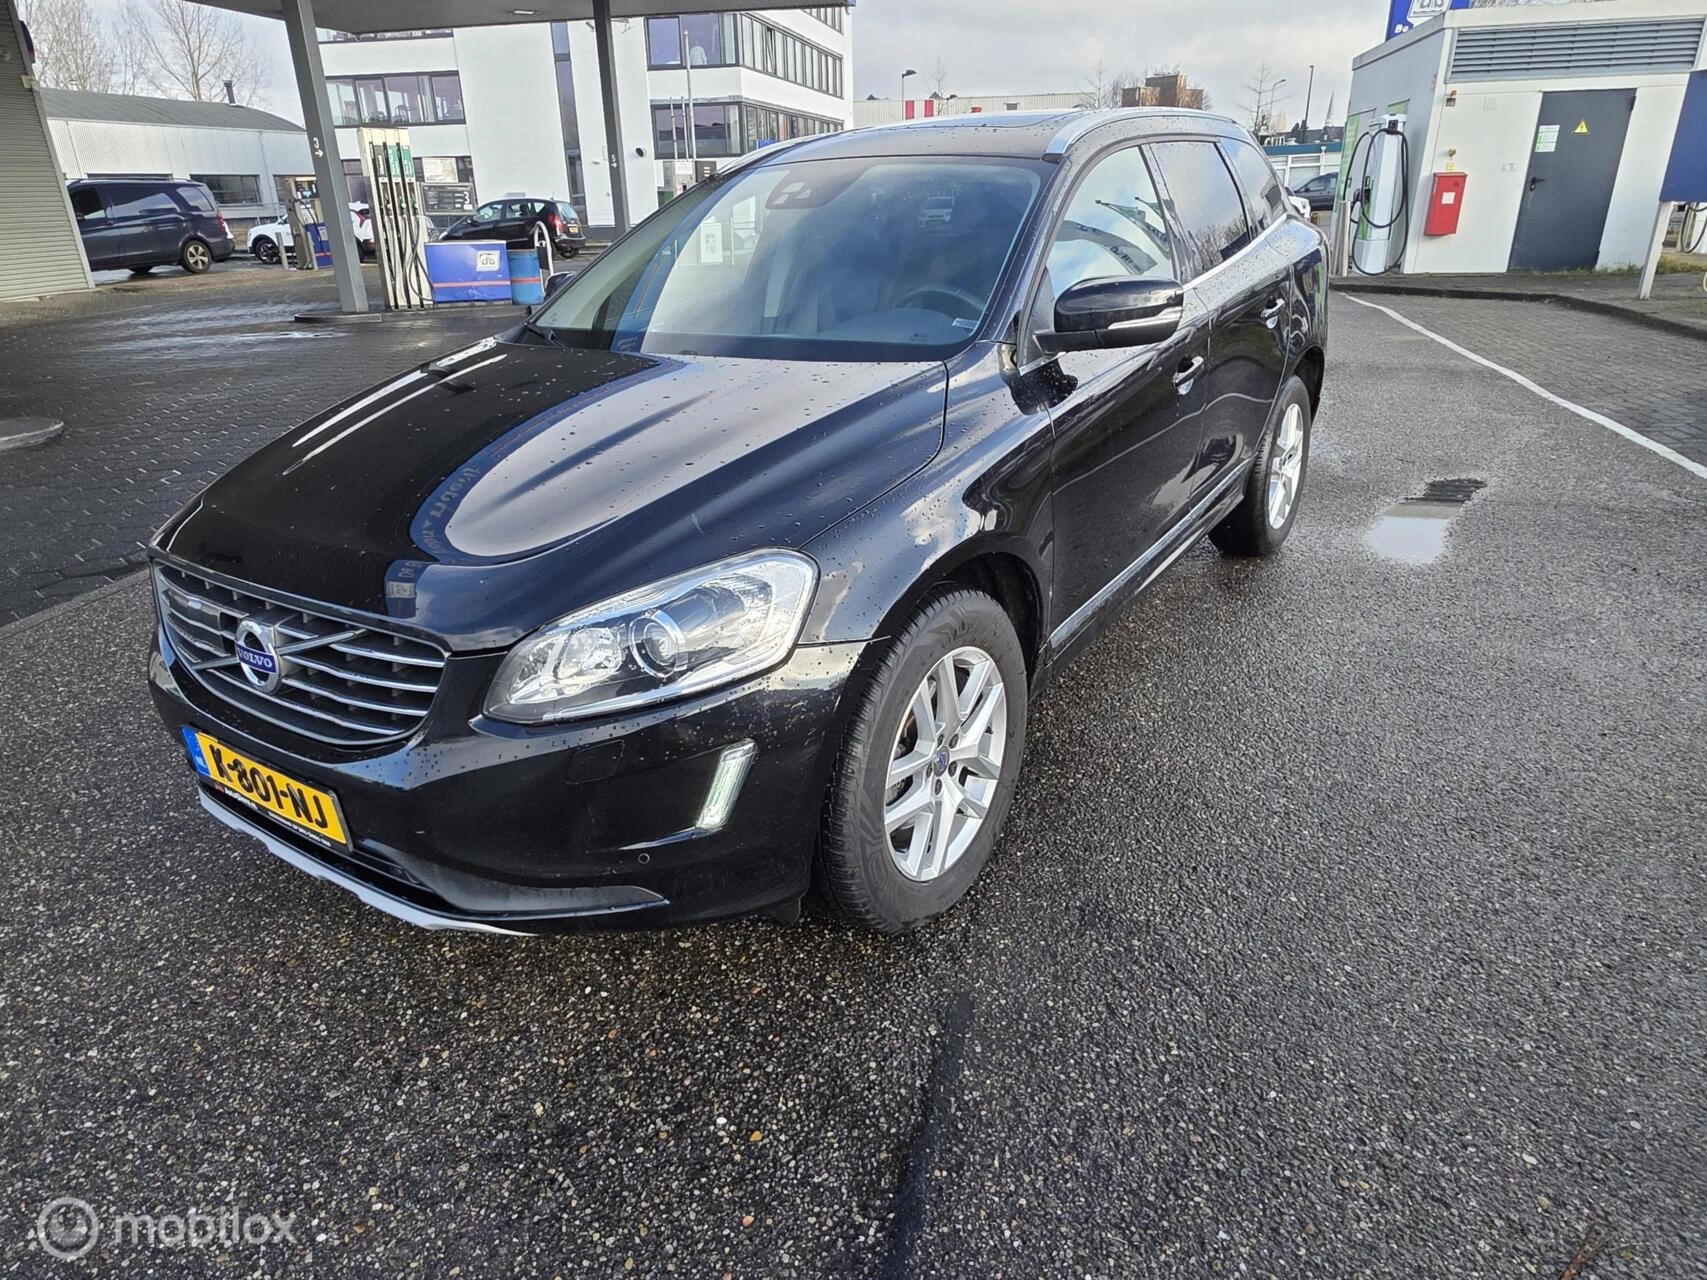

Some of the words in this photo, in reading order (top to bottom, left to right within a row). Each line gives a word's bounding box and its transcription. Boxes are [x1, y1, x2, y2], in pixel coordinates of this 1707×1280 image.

[313, 137, 320, 149] 3
[463, 191, 470, 204] 3
[237, 647, 273, 669] VOLVO
[209, 744, 328, 829] K-801-NJ
